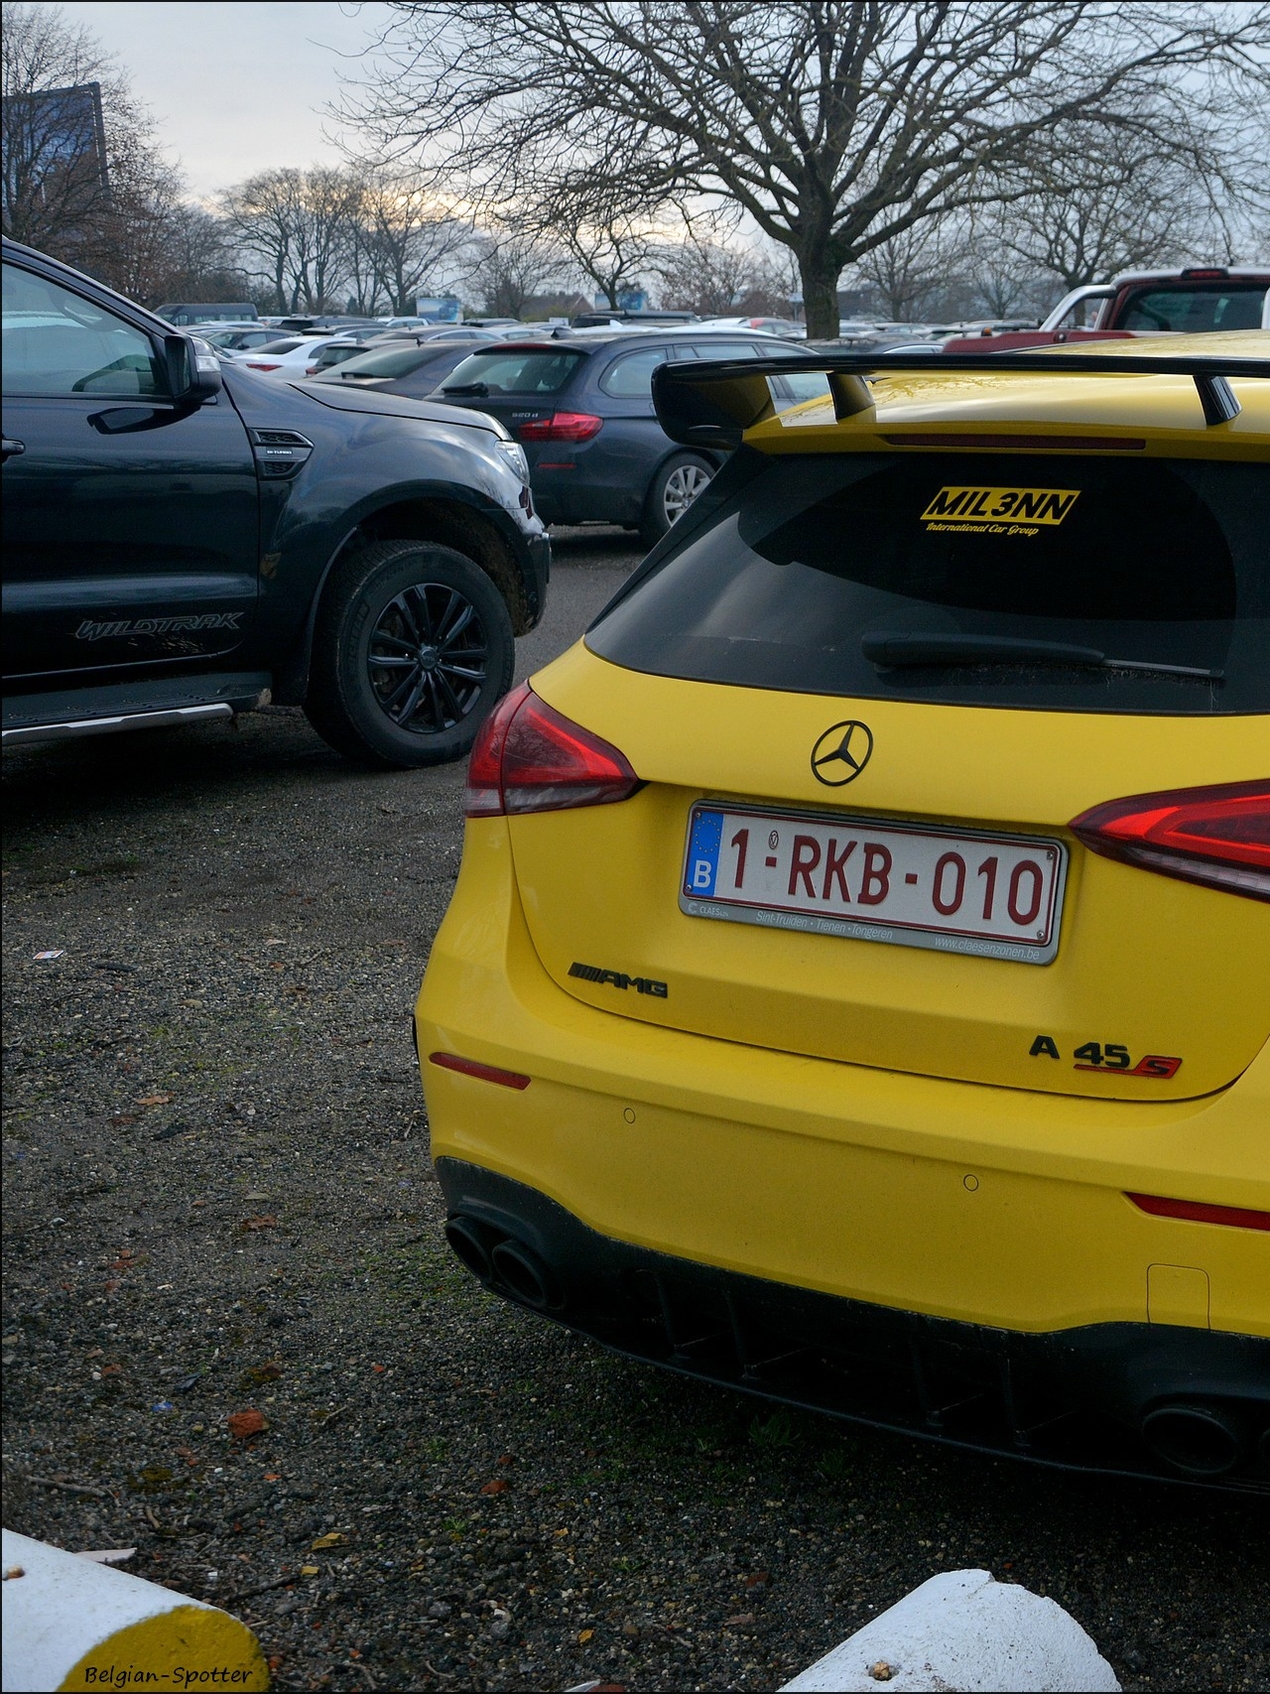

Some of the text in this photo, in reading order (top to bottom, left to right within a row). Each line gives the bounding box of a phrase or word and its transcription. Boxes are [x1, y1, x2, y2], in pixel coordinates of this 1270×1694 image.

[926, 490, 1077, 521] MIL3NN
[925, 522, 1040, 537] International Car Group
[75, 611, 246, 641] WILDTRAK
[693, 859, 713, 889] B
[730, 828, 1044, 926] 1-RKB-010
[755, 910, 894, 940] Sint-Truiden Tienen Tongeren
[934, 936, 1040, 961] www.claesenzonen.be
[598, 968, 668, 998] AMG
[1028, 1035, 1060, 1060] A
[1073, 1041, 1131, 1069] 45
